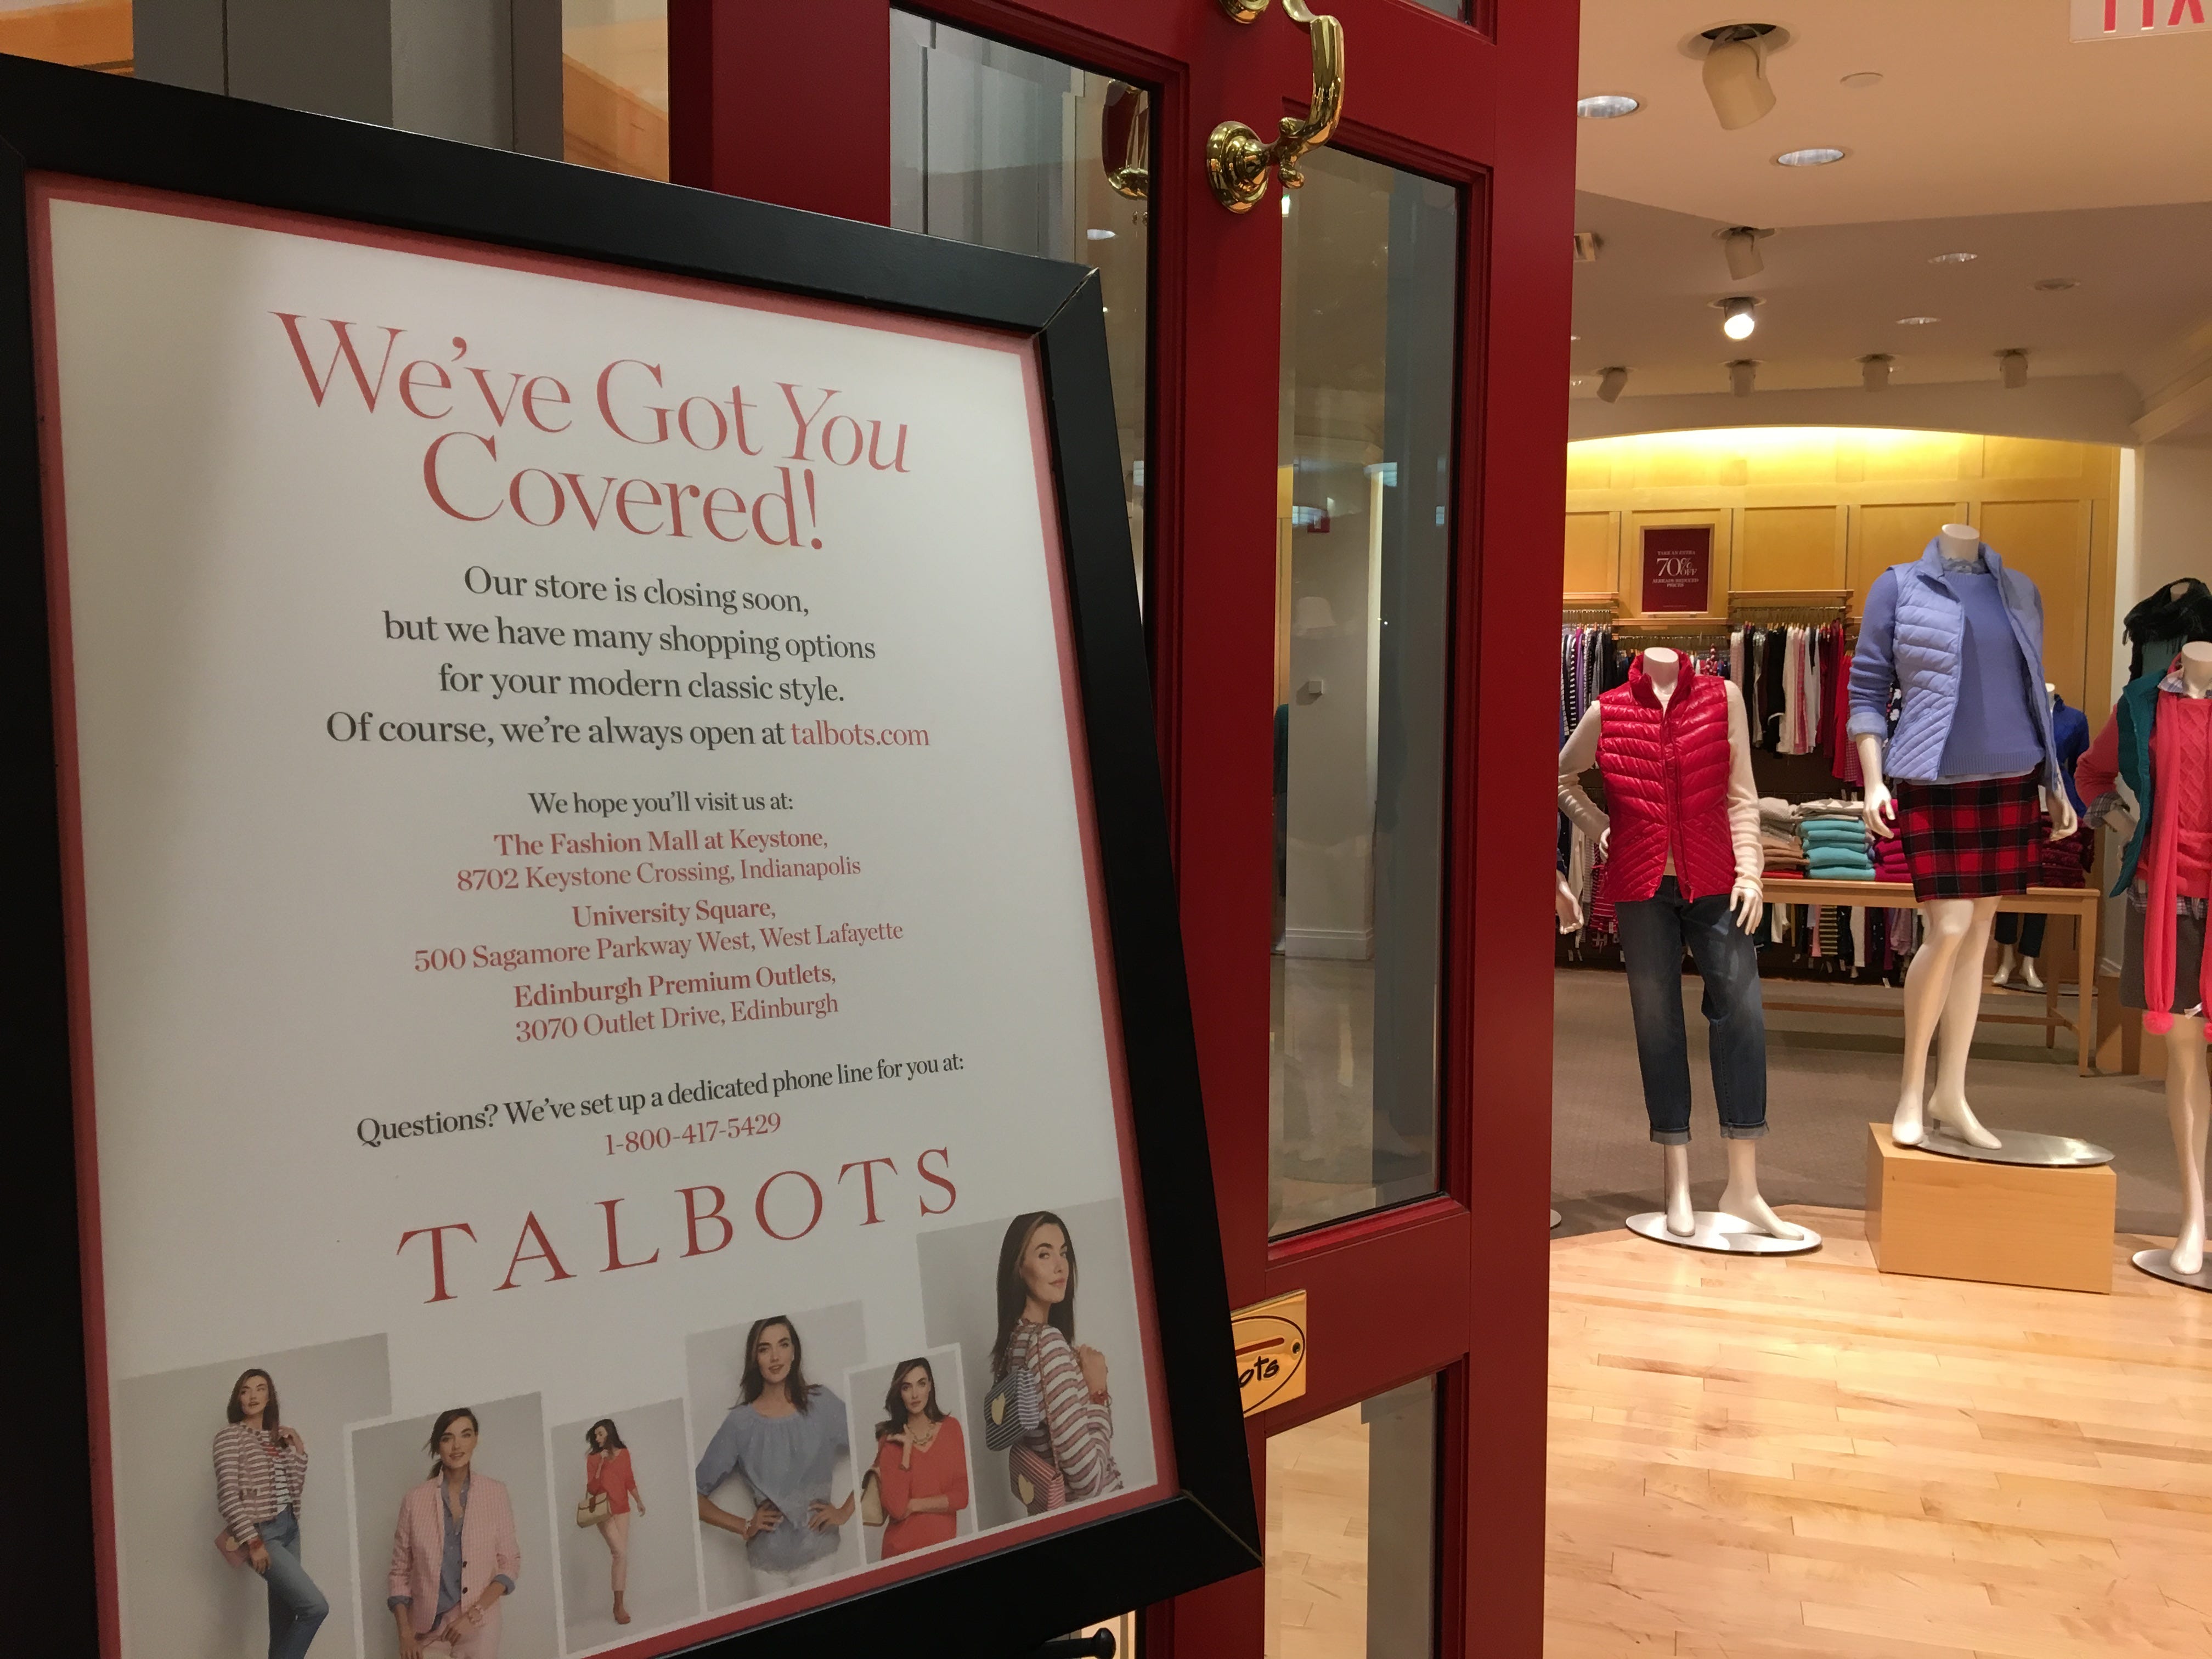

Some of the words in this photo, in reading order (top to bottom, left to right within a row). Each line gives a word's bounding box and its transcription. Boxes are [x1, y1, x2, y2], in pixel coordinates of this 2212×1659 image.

[268, 312, 572, 433] We've
[597, 360, 761, 455] Got
[777, 383, 910, 472] You
[424, 432, 822, 549] Covered!
[1656, 557, 1692, 577] 70%
[465, 566, 527, 596] Our
[535, 575, 607, 601] store
[614, 577, 636, 602] is
[644, 578, 737, 614] closing
[742, 592, 808, 617] soon,
[382, 610, 439, 641] but
[444, 623, 489, 643] we
[495, 616, 565, 646] have
[573, 629, 653, 656] many
[659, 625, 780, 661] shopping
[786, 634, 876, 662] options
[439, 663, 483, 692] for
[489, 674, 561, 699] your
[568, 669, 682, 697] modern
[689, 672, 773, 699] classic
[780, 676, 844, 707] style.
[327, 712, 373, 742] Of
[379, 722, 494, 747] course,
[500, 715, 580, 743] we're
[589, 716, 682, 751] always
[690, 726, 756, 751] open
[762, 723, 786, 744] at
[791, 720, 929, 746] talbots.com
[528, 793, 567, 814] We
[573, 792, 627, 817] hope
[632, 791, 690, 817] you'll
[695, 792, 739, 811] visit
[742, 797, 765, 810] us
[770, 793, 793, 810] at:
[494, 834, 543, 856] The
[550, 832, 641, 854] Fashion
[647, 830, 699, 851] Mall
[704, 832, 724, 849] at
[730, 829, 827, 853] Keystone,
[458, 868, 518, 890] 8702
[526, 866, 631, 892] Keystone
[637, 862, 735, 885] Crossing,
[741, 856, 860, 881] Indianapolis
[572, 902, 690, 927] University
[696, 900, 775, 924] Square,
[415, 948, 466, 972] 500
[473, 945, 590, 971] Sagamore
[597, 936, 691, 959] Parkway
[696, 931, 755, 952] West,
[759, 927, 811, 947] West
[815, 923, 903, 946] Lafayette
[514, 977, 642, 1007] Edinburgh
[648, 972, 751, 996] Premium
[756, 964, 836, 987] Outlets,
[516, 1017, 578, 1042] 3070
[584, 1011, 656, 1036] Outlet
[661, 1006, 725, 1028] Drive,
[730, 993, 838, 1022] Edinburgh
[357, 1104, 498, 1147] Questions?
[503, 1098, 575, 1125] We've
[581, 1094, 613, 1115] set
[617, 1094, 645, 1115] up
[651, 1092, 664, 1107] a
[668, 1072, 769, 1104] dedicated
[772, 1070, 833, 1097] phone
[837, 1064, 872, 1084] line
[877, 1059, 902, 1079] for
[906, 1059, 939, 1081] you
[943, 1053, 963, 1071] at:
[607, 1113, 781, 1155] 1-800-417-5429
[397, 1147, 956, 1304] TALBOTS
[1238, 1356, 1280, 1388] ots
